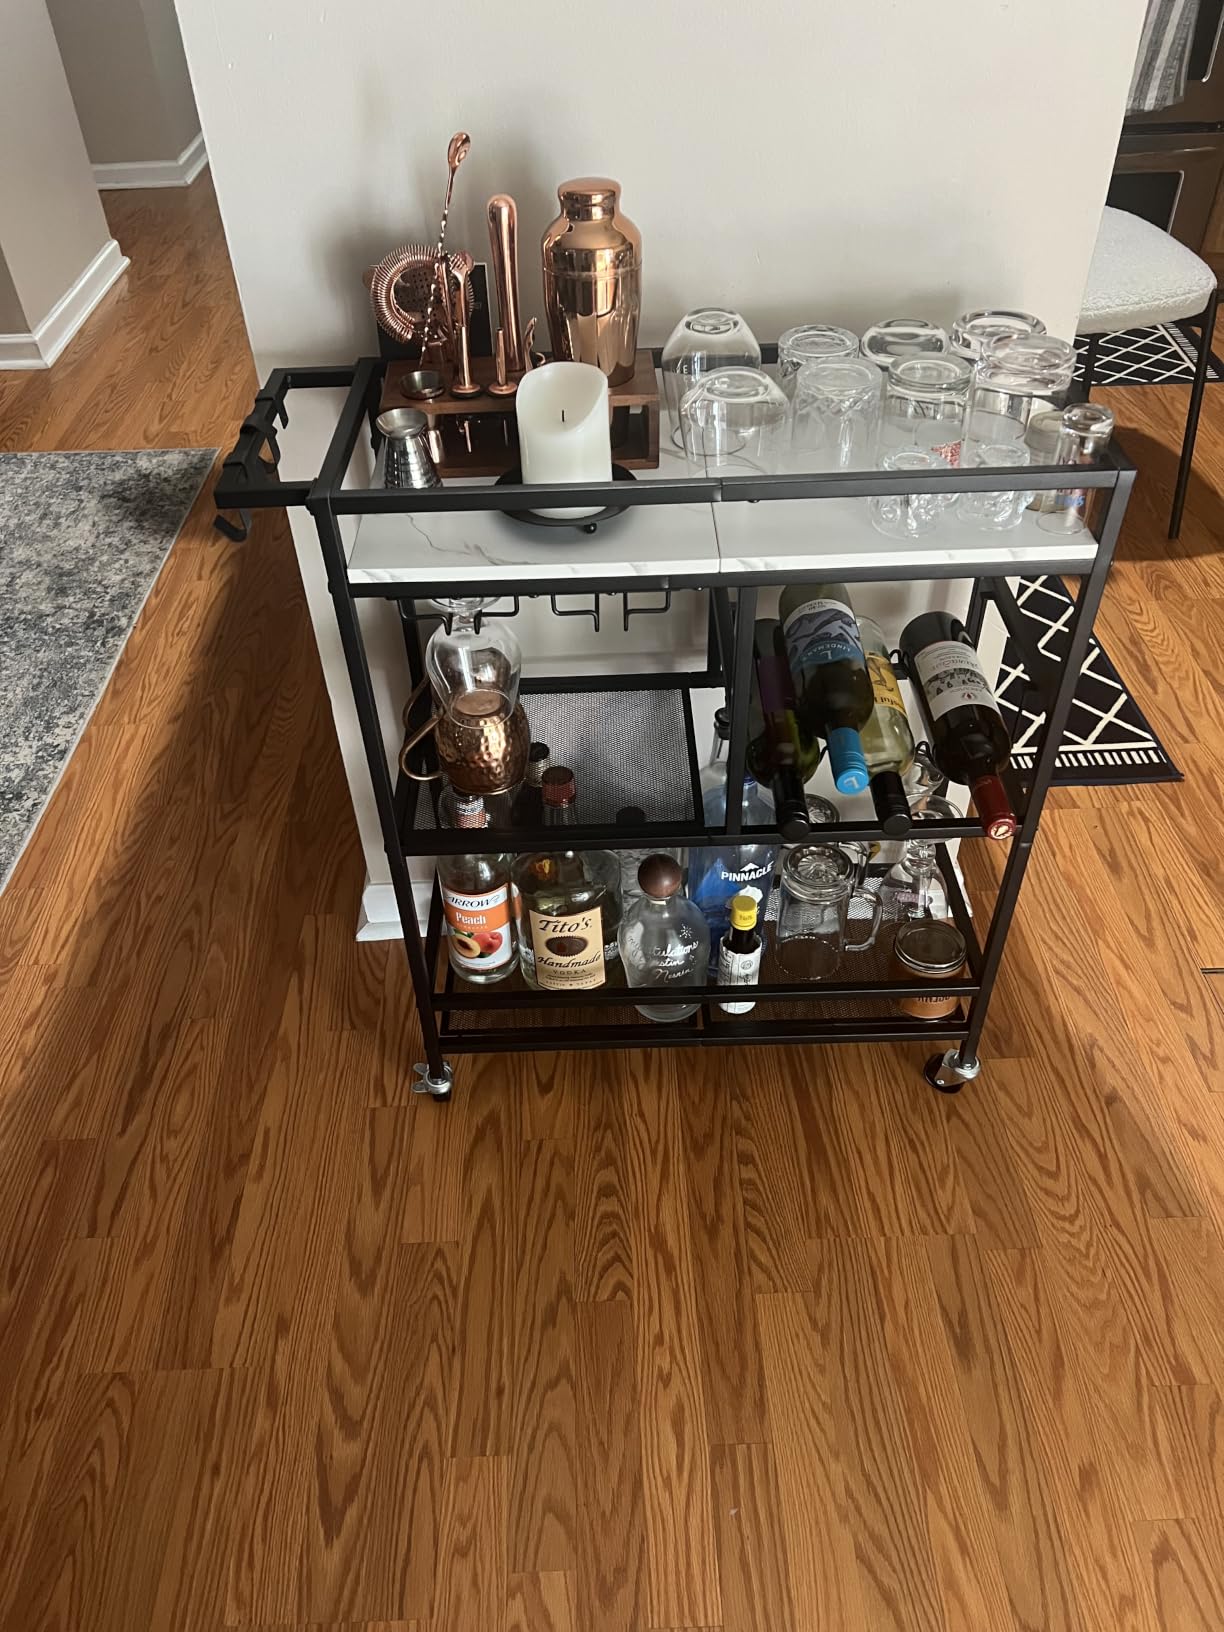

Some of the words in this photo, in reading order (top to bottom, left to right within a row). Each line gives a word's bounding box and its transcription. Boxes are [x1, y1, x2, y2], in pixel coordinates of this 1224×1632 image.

[721, 861, 774, 882] PINNACLE
[447, 894, 500, 909] ARROW
[455, 911, 486, 925] Peach
[539, 917, 592, 933] Tito's
[537, 950, 601, 968] Handmade
